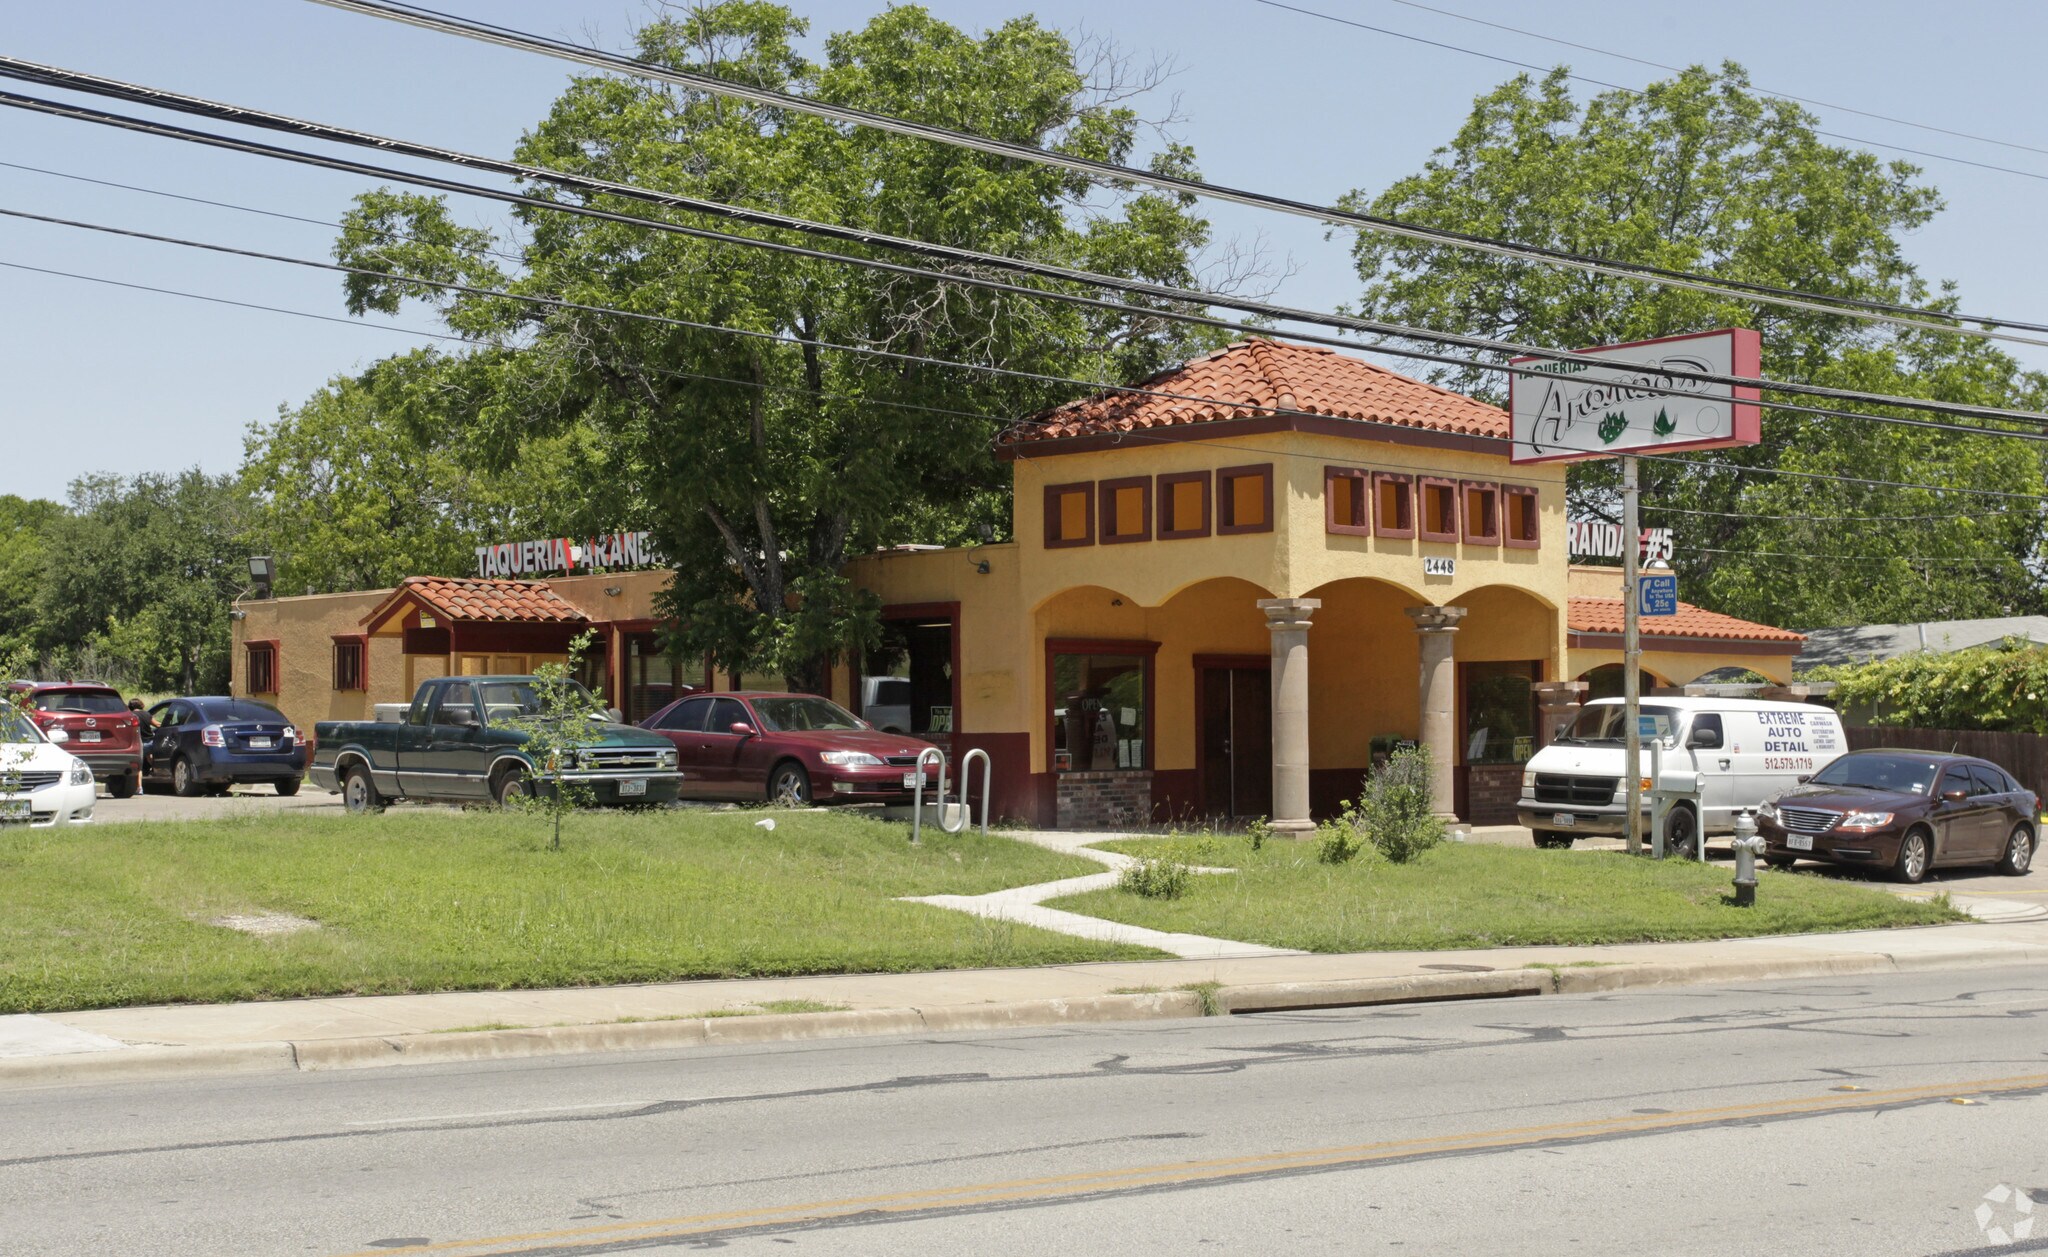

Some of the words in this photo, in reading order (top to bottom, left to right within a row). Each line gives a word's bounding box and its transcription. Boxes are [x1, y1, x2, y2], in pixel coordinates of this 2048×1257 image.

[1646, 527, 1673, 560] #5
[475, 538, 567, 577] TAQUERIA
[1426, 558, 1454, 574] 2448
[1654, 579, 1670, 587] Call
[1757, 711, 1805, 725] EXTREME
[1768, 727, 1802, 738] AUTO
[1765, 741, 1808, 752] DETAIL
[1765, 757, 1813, 770] 512.579.1719
